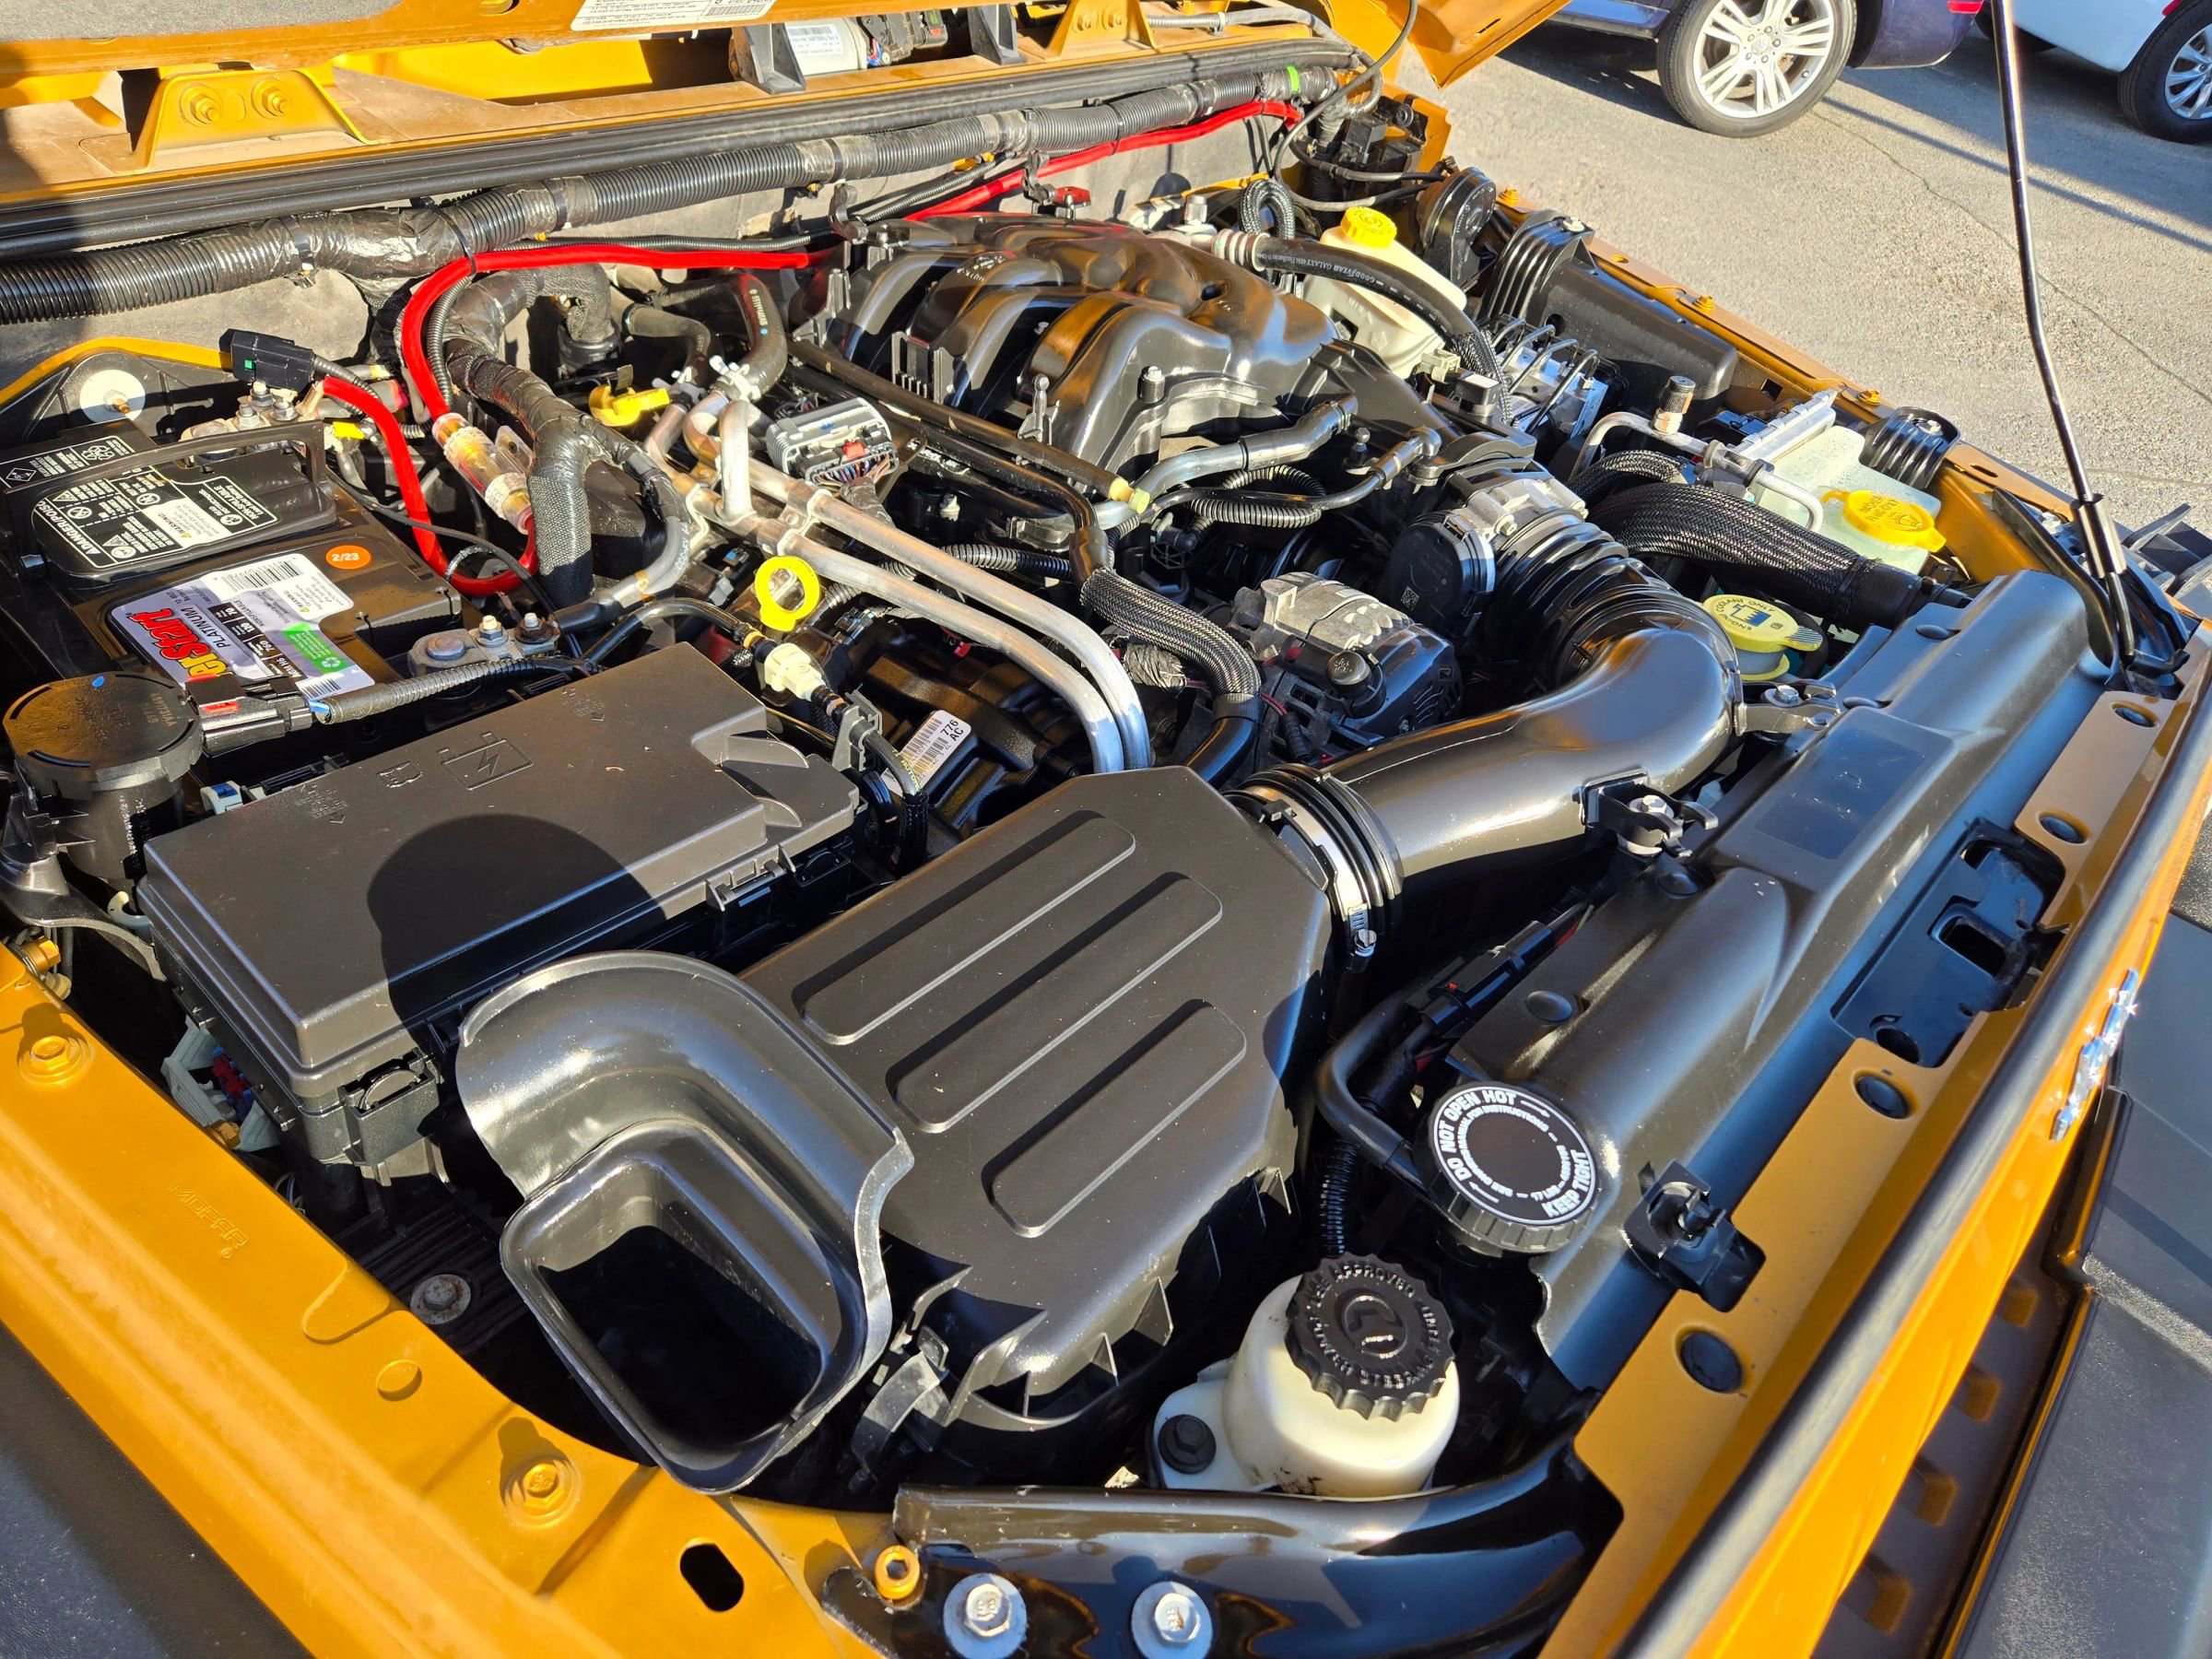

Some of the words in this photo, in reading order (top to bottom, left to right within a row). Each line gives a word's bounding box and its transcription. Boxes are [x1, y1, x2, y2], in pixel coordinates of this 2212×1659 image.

[1333, 264, 1376, 283] GOODYEAR
[212, 485, 259, 520] NON-SPILLABLE
[35, 500, 95, 549] DANGER/POISO
[331, 551, 359, 564] 2/23
[232, 598, 265, 627] NONSPILLABLE
[1716, 598, 1744, 613] COOLANT
[1748, 601, 1776, 612] ONLY
[180, 605, 230, 649] PLATINUM
[129, 607, 233, 679] erStart
[940, 718, 959, 737] 776
[949, 726, 964, 742] AC
[1443, 1092, 1482, 1122] OPEN
[1481, 1090, 1517, 1105] HOT
[1482, 1105, 1549, 1133] INSTRUCTIONS
[1439, 1120, 1456, 1153] NOT
[1447, 1158, 1472, 1181] DO
[1541, 1189, 1581, 1218] KEEP
[1570, 1149, 1591, 1192] TIGHT
[166, 1182, 249, 1250] MOPAR
